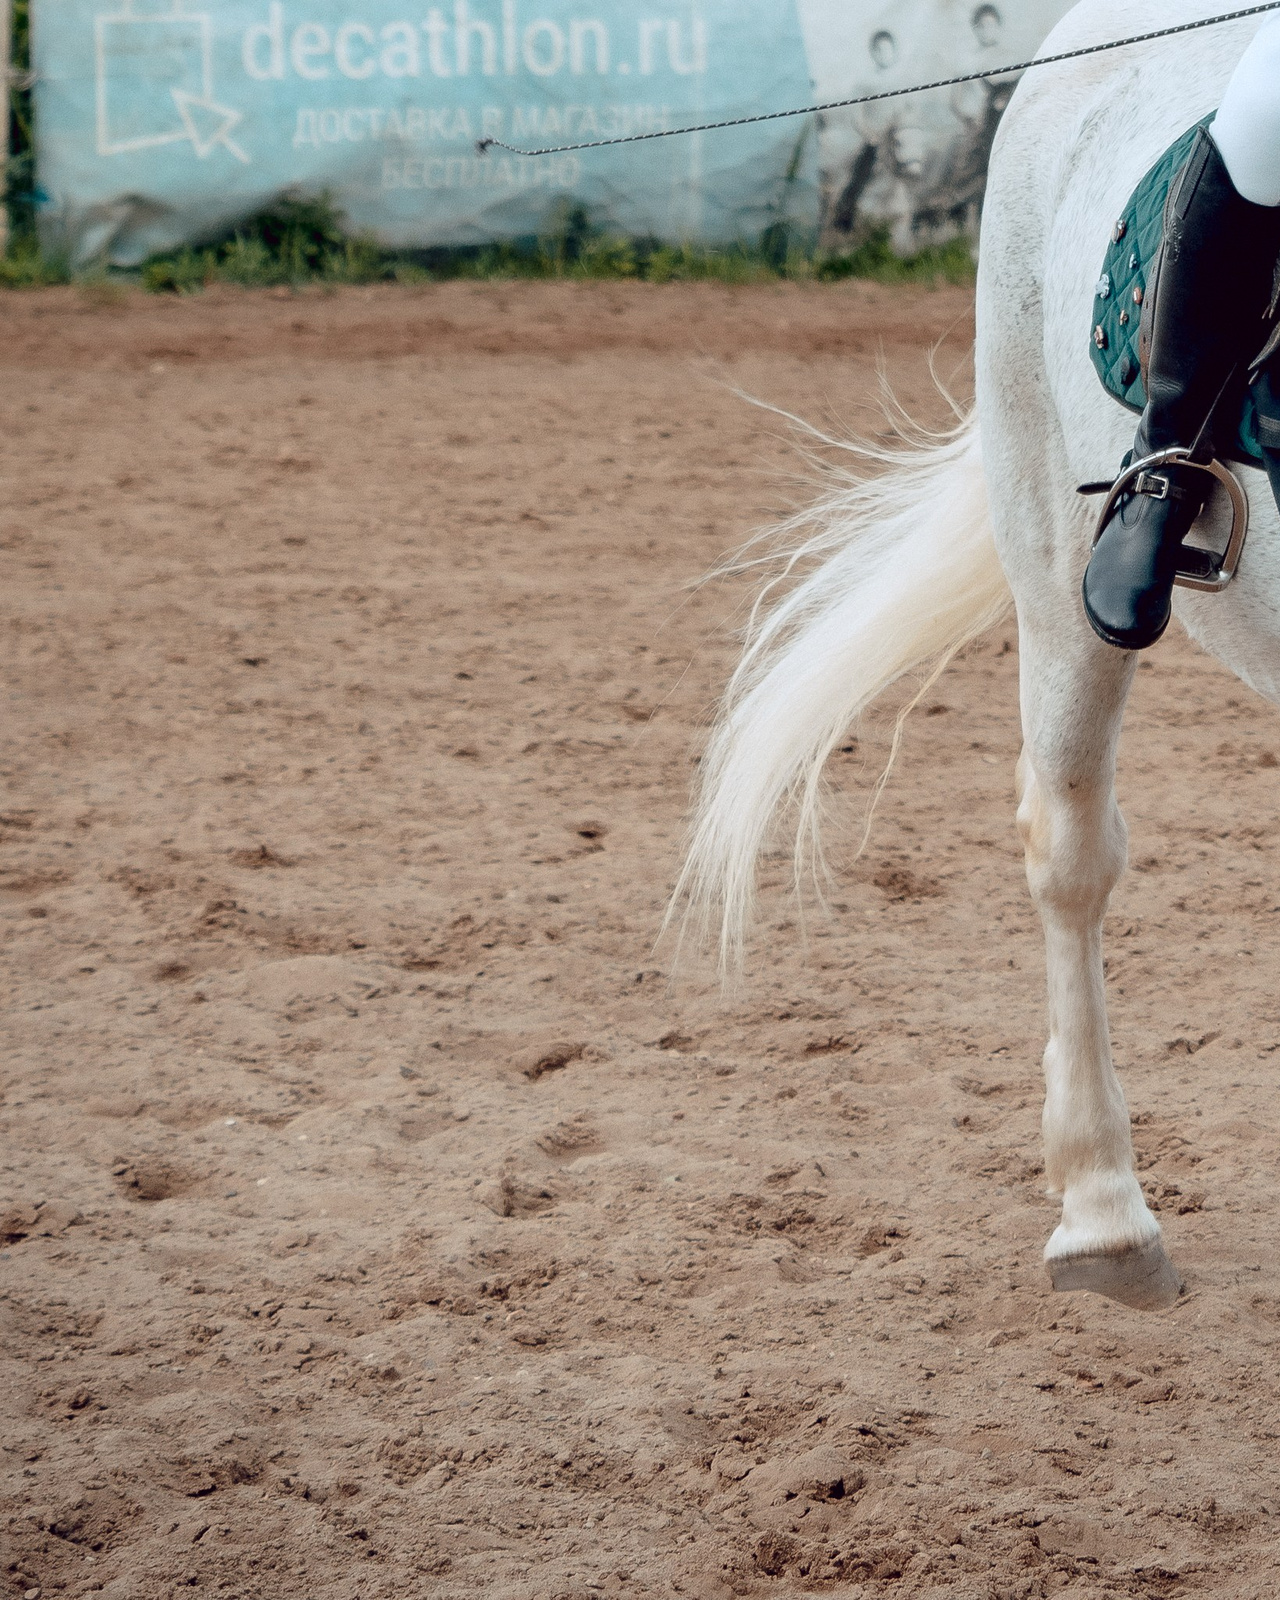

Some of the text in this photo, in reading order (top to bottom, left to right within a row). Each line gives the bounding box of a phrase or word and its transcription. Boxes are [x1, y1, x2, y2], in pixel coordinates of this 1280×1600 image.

[292, 105, 471, 148] ДОСТАВКА
[512, 102, 671, 138] МАГАЗИН
[380, 156, 580, 190] БЕСПЛАТНО
